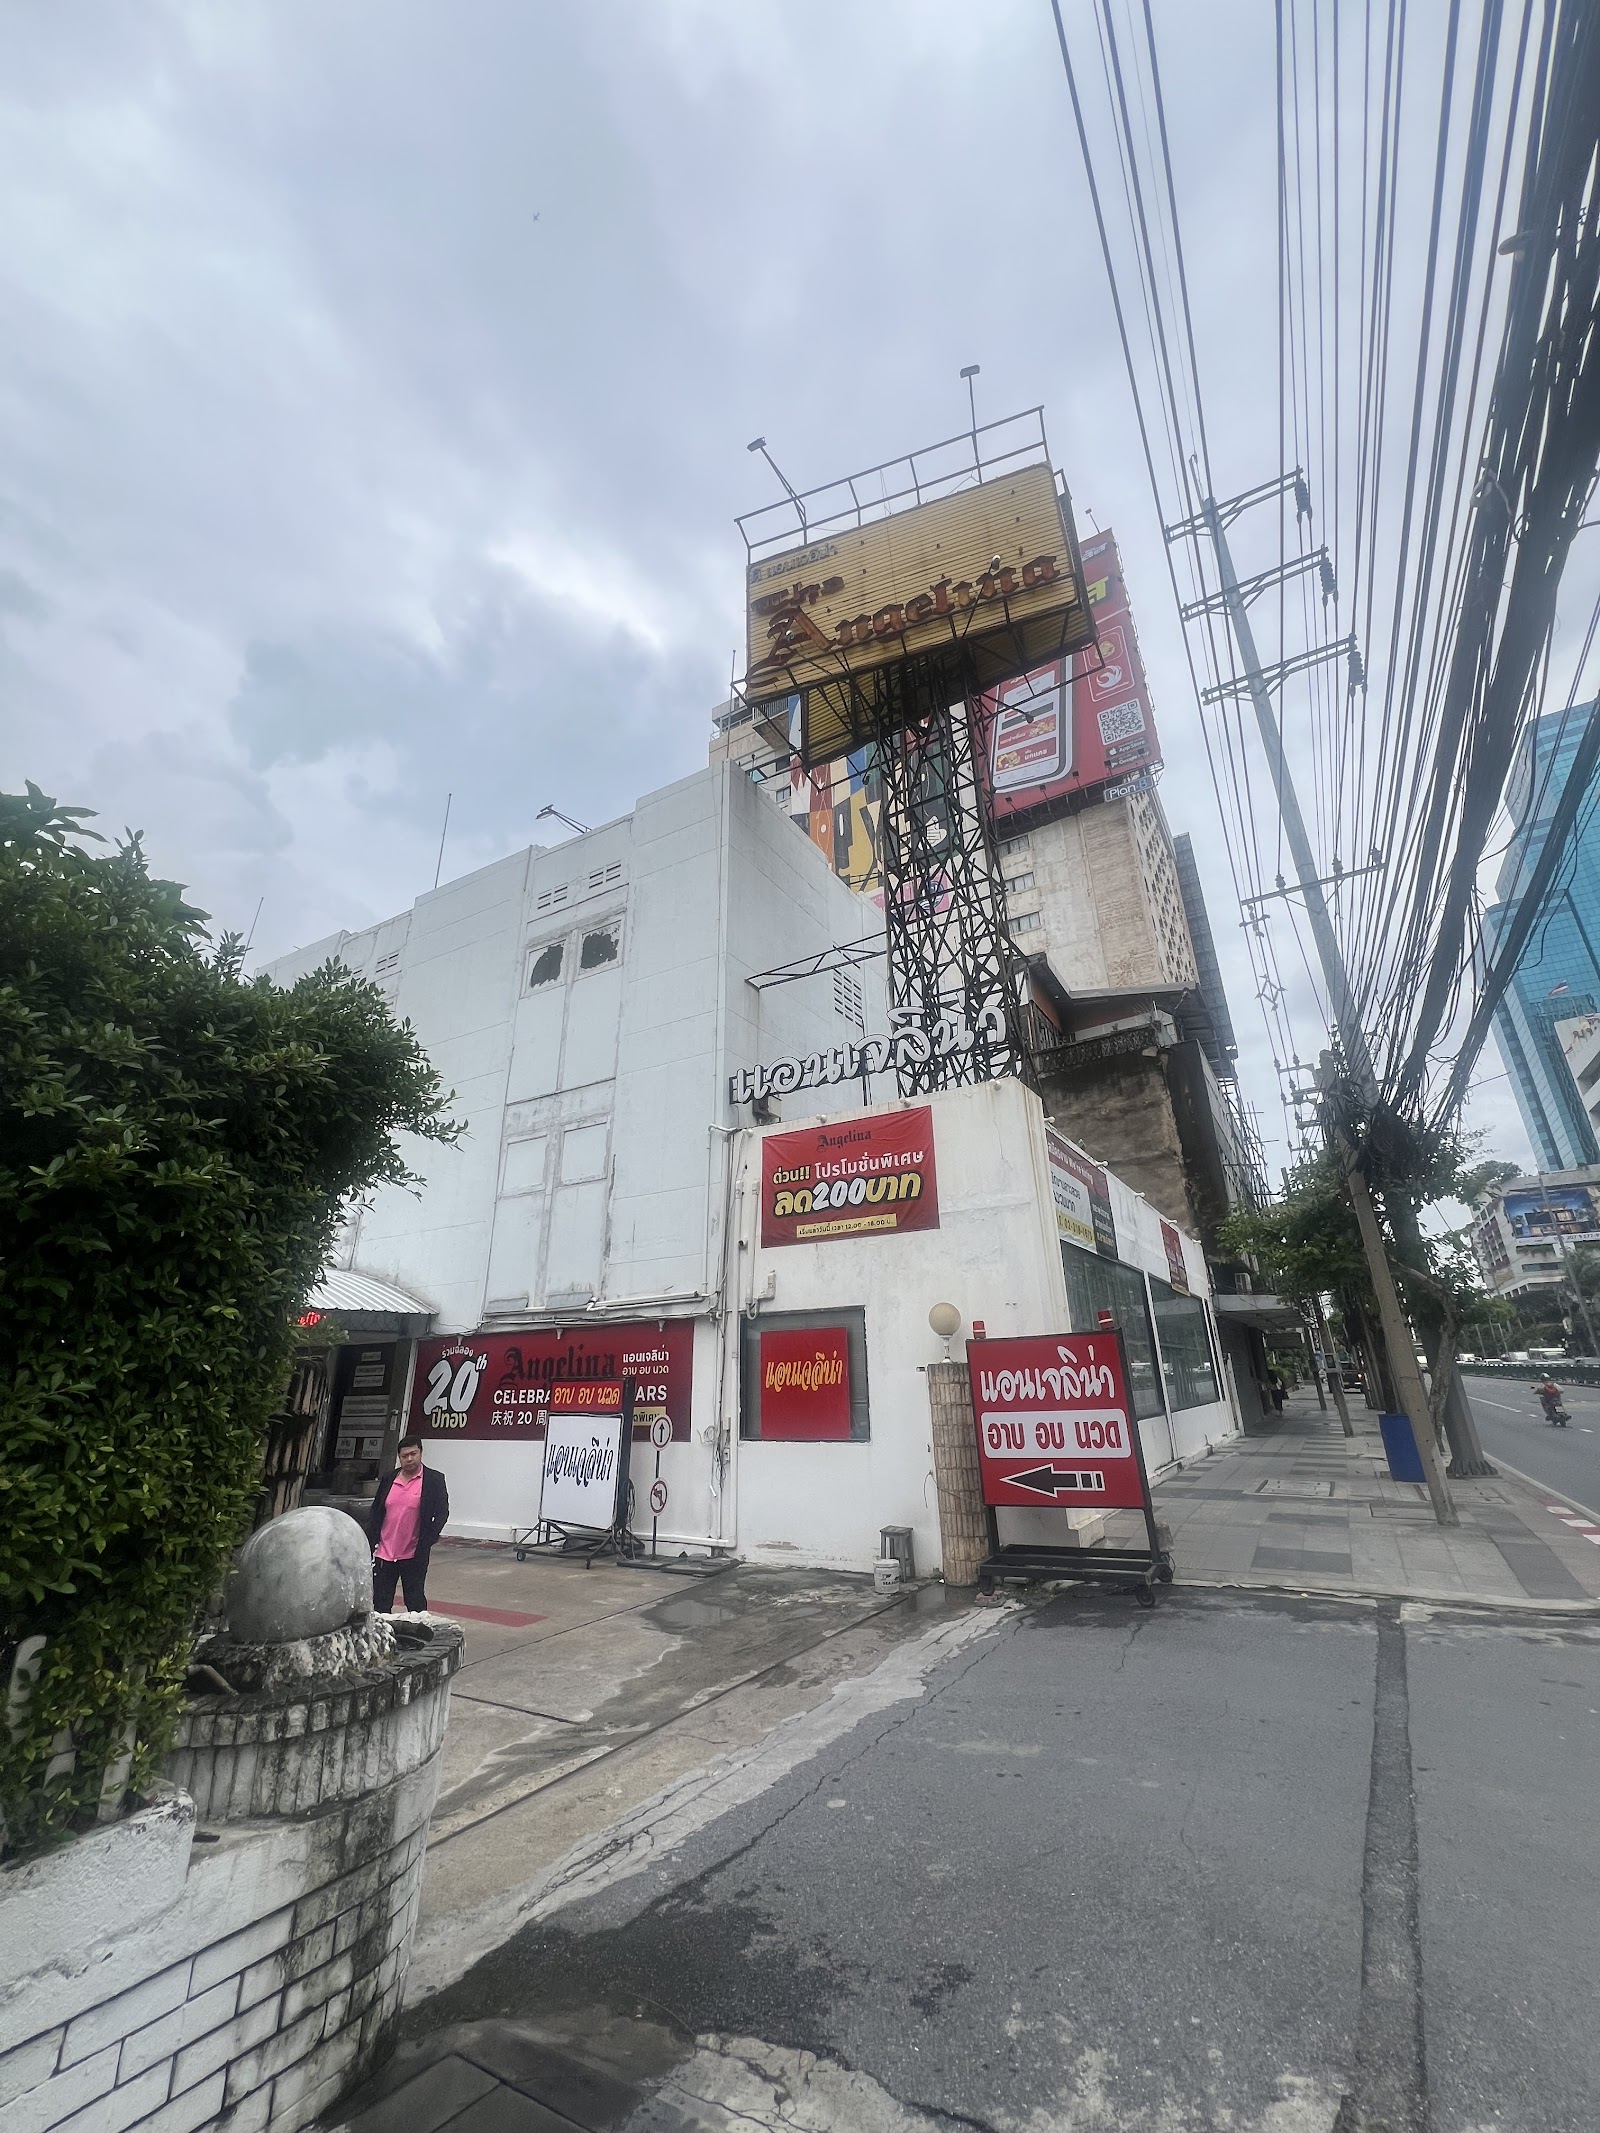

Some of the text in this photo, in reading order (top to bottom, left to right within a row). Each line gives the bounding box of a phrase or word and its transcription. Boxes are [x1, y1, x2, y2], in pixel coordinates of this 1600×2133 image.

[746, 555, 1060, 688] Angelina
[1109, 784, 1136, 799] Plan
[735, 989, 1007, 1104] แอนเจลิน่า
[816, 1129, 873, 1154] Angelina
[772, 1149, 924, 1184] ด่วน!! โปรโมชั่นพิเศษ
[499, 1344, 616, 1391] Angelina
[622, 1365, 669, 1375] อาบ อบ นวด
[980, 1345, 1116, 1403] แอนเจลิน่า
[554, 1387, 620, 1405] อาบ อบ นวด
[635, 1385, 667, 1401] ARS
[431, 1406, 468, 1428] ปีทอง
[491, 1410, 513, 1426] 庆祝
[517, 1412, 532, 1425] 20
[987, 1420, 1122, 1450] อาบ อบ นวด
